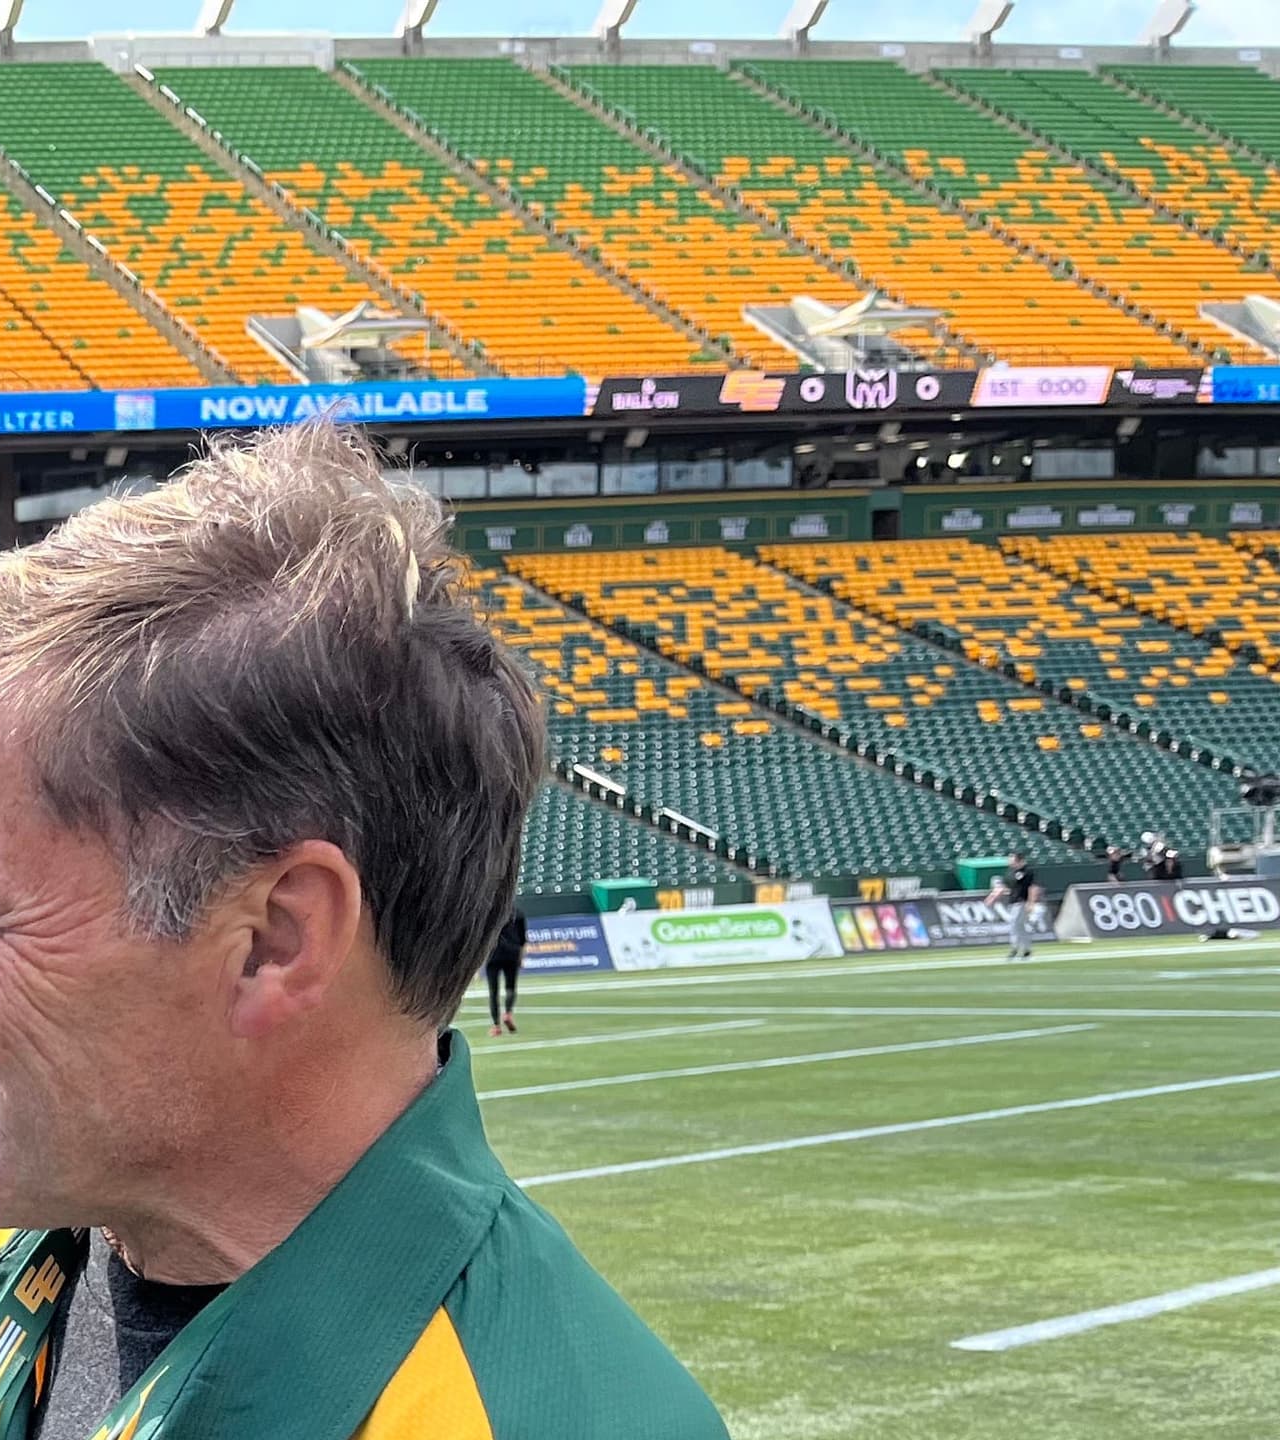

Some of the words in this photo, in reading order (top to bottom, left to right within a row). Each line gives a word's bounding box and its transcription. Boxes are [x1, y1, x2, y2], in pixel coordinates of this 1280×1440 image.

[1040, 378, 1088, 396] 0:00
[200, 395, 289, 421] NOW
[293, 389, 489, 417] AVAILABLE
[1089, 892, 1162, 931] 880
[1174, 886, 1280, 926] CHED
[657, 918, 781, 942] GameSense
